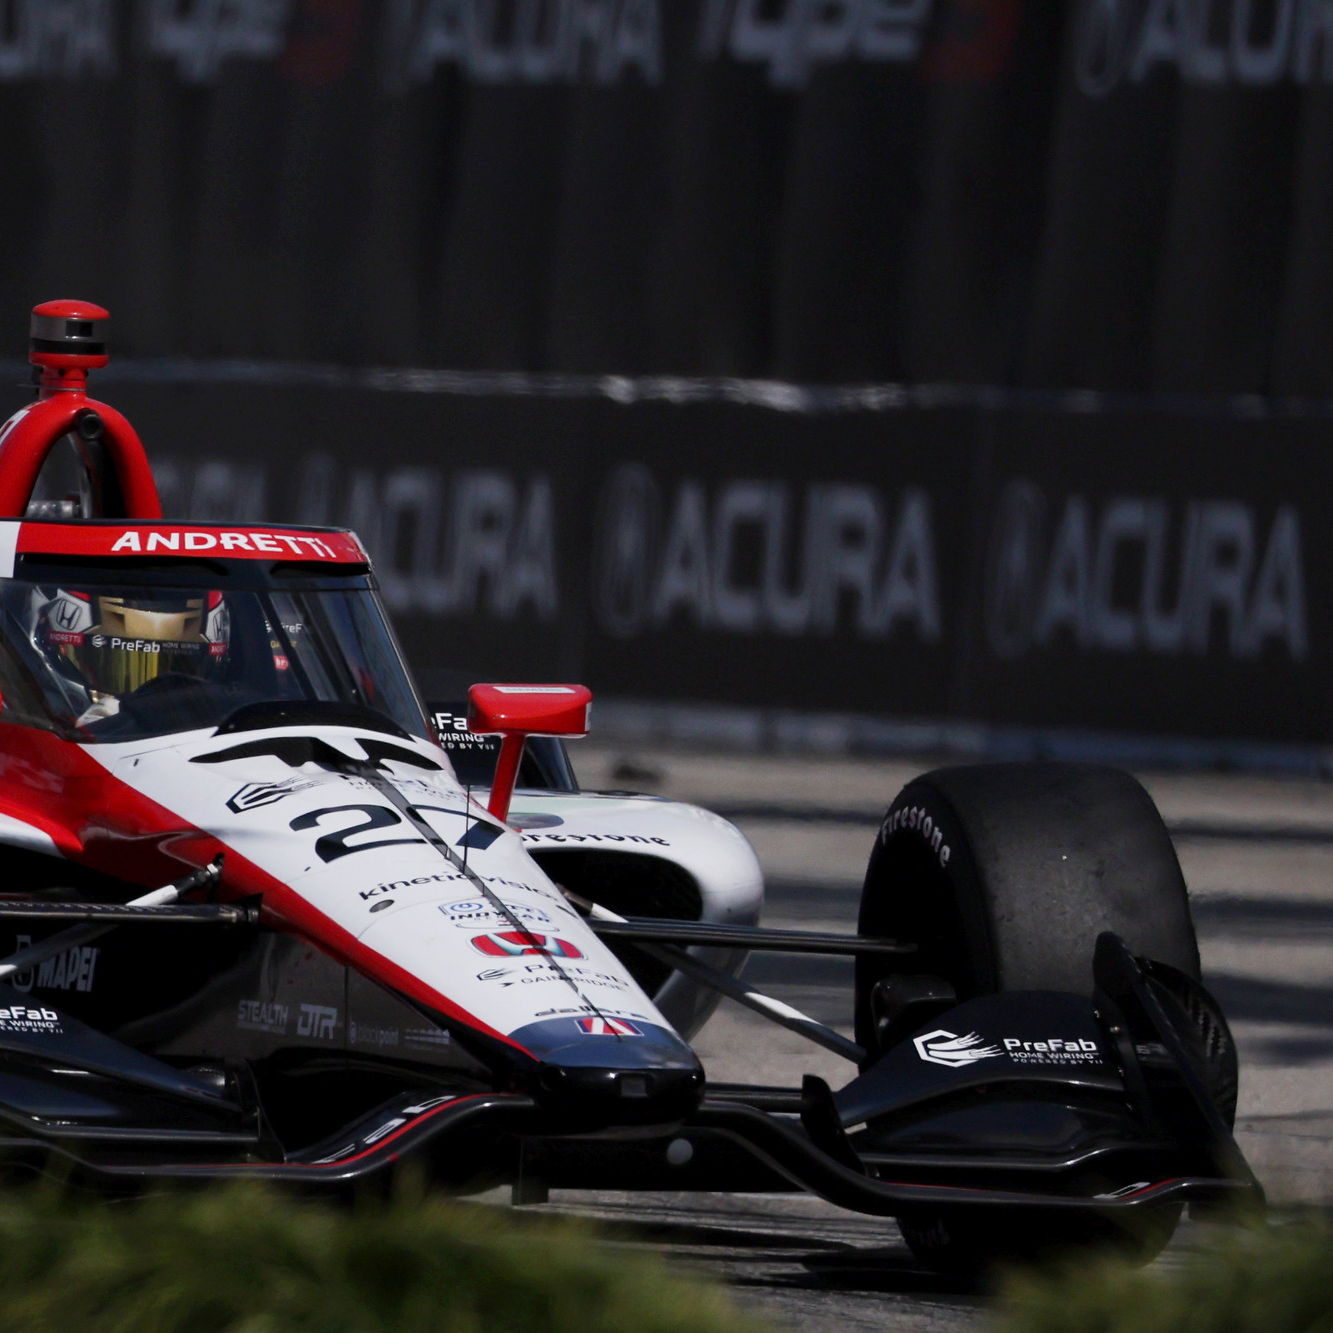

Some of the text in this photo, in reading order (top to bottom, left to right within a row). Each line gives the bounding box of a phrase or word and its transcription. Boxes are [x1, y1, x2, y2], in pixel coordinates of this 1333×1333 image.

[110, 531, 338, 559] ANDRETTI
[653, 480, 941, 642] ACURA
[1037, 495, 1307, 662] ACURA
[110, 636, 161, 654] PreFab
[288, 803, 507, 864] 27
[880, 804, 952, 870] Firestone
[36, 945, 98, 993] MAPEI
[237, 1000, 289, 1025] STEALTH
[1003, 1038, 1097, 1051] PreFab
[1008, 1051, 1044, 1060] HOME
